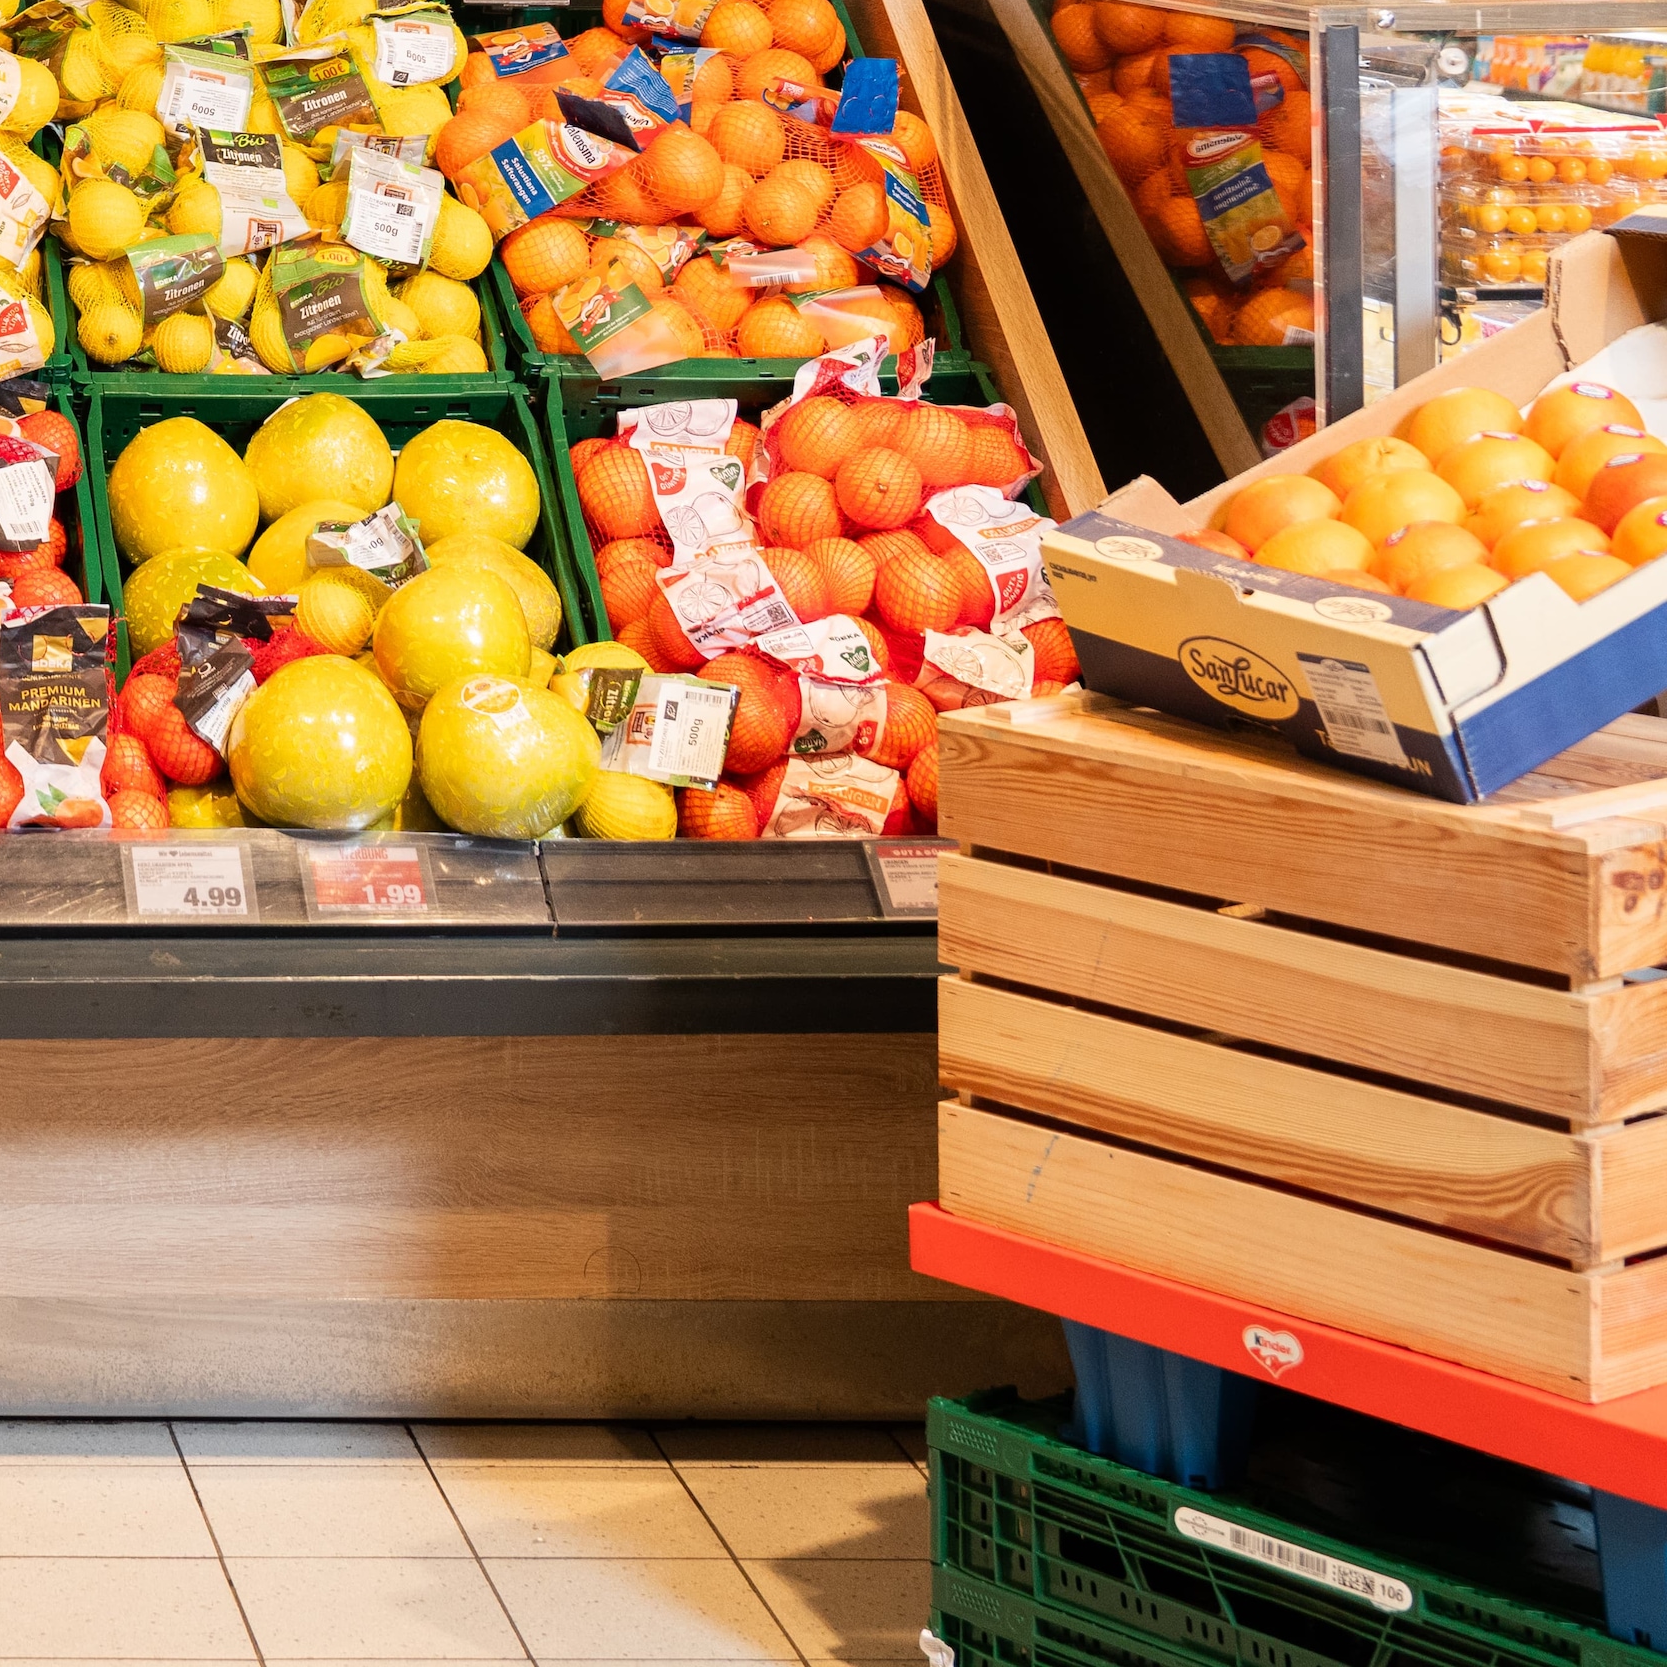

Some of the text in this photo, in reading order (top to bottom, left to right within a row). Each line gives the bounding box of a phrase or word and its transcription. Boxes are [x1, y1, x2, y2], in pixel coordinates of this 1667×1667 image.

[406, 49, 427, 65] 500g
[192, 102, 216, 116] 500g
[301, 89, 347, 113] Zitronen
[235, 134, 266, 148] Bio
[563, 123, 597, 165] Valensina
[221, 147, 263, 163] Zitronen
[500, 158, 532, 204] Saftorangen
[510, 157, 538, 197] Salustiana
[374, 221, 399, 237] 500g
[164, 279, 204, 301] Zitronen
[299, 293, 342, 319] Zitronen
[1190, 648, 1289, 703] SanLucar
[21, 686, 85, 700] PREMIUM
[8, 697, 100, 711] MANDARINEN
[688, 718, 704, 746] 500g
[183, 886, 242, 906] 4.99
[362, 884, 422, 904] 1.99
[1380, 1584, 1404, 1602] 106
